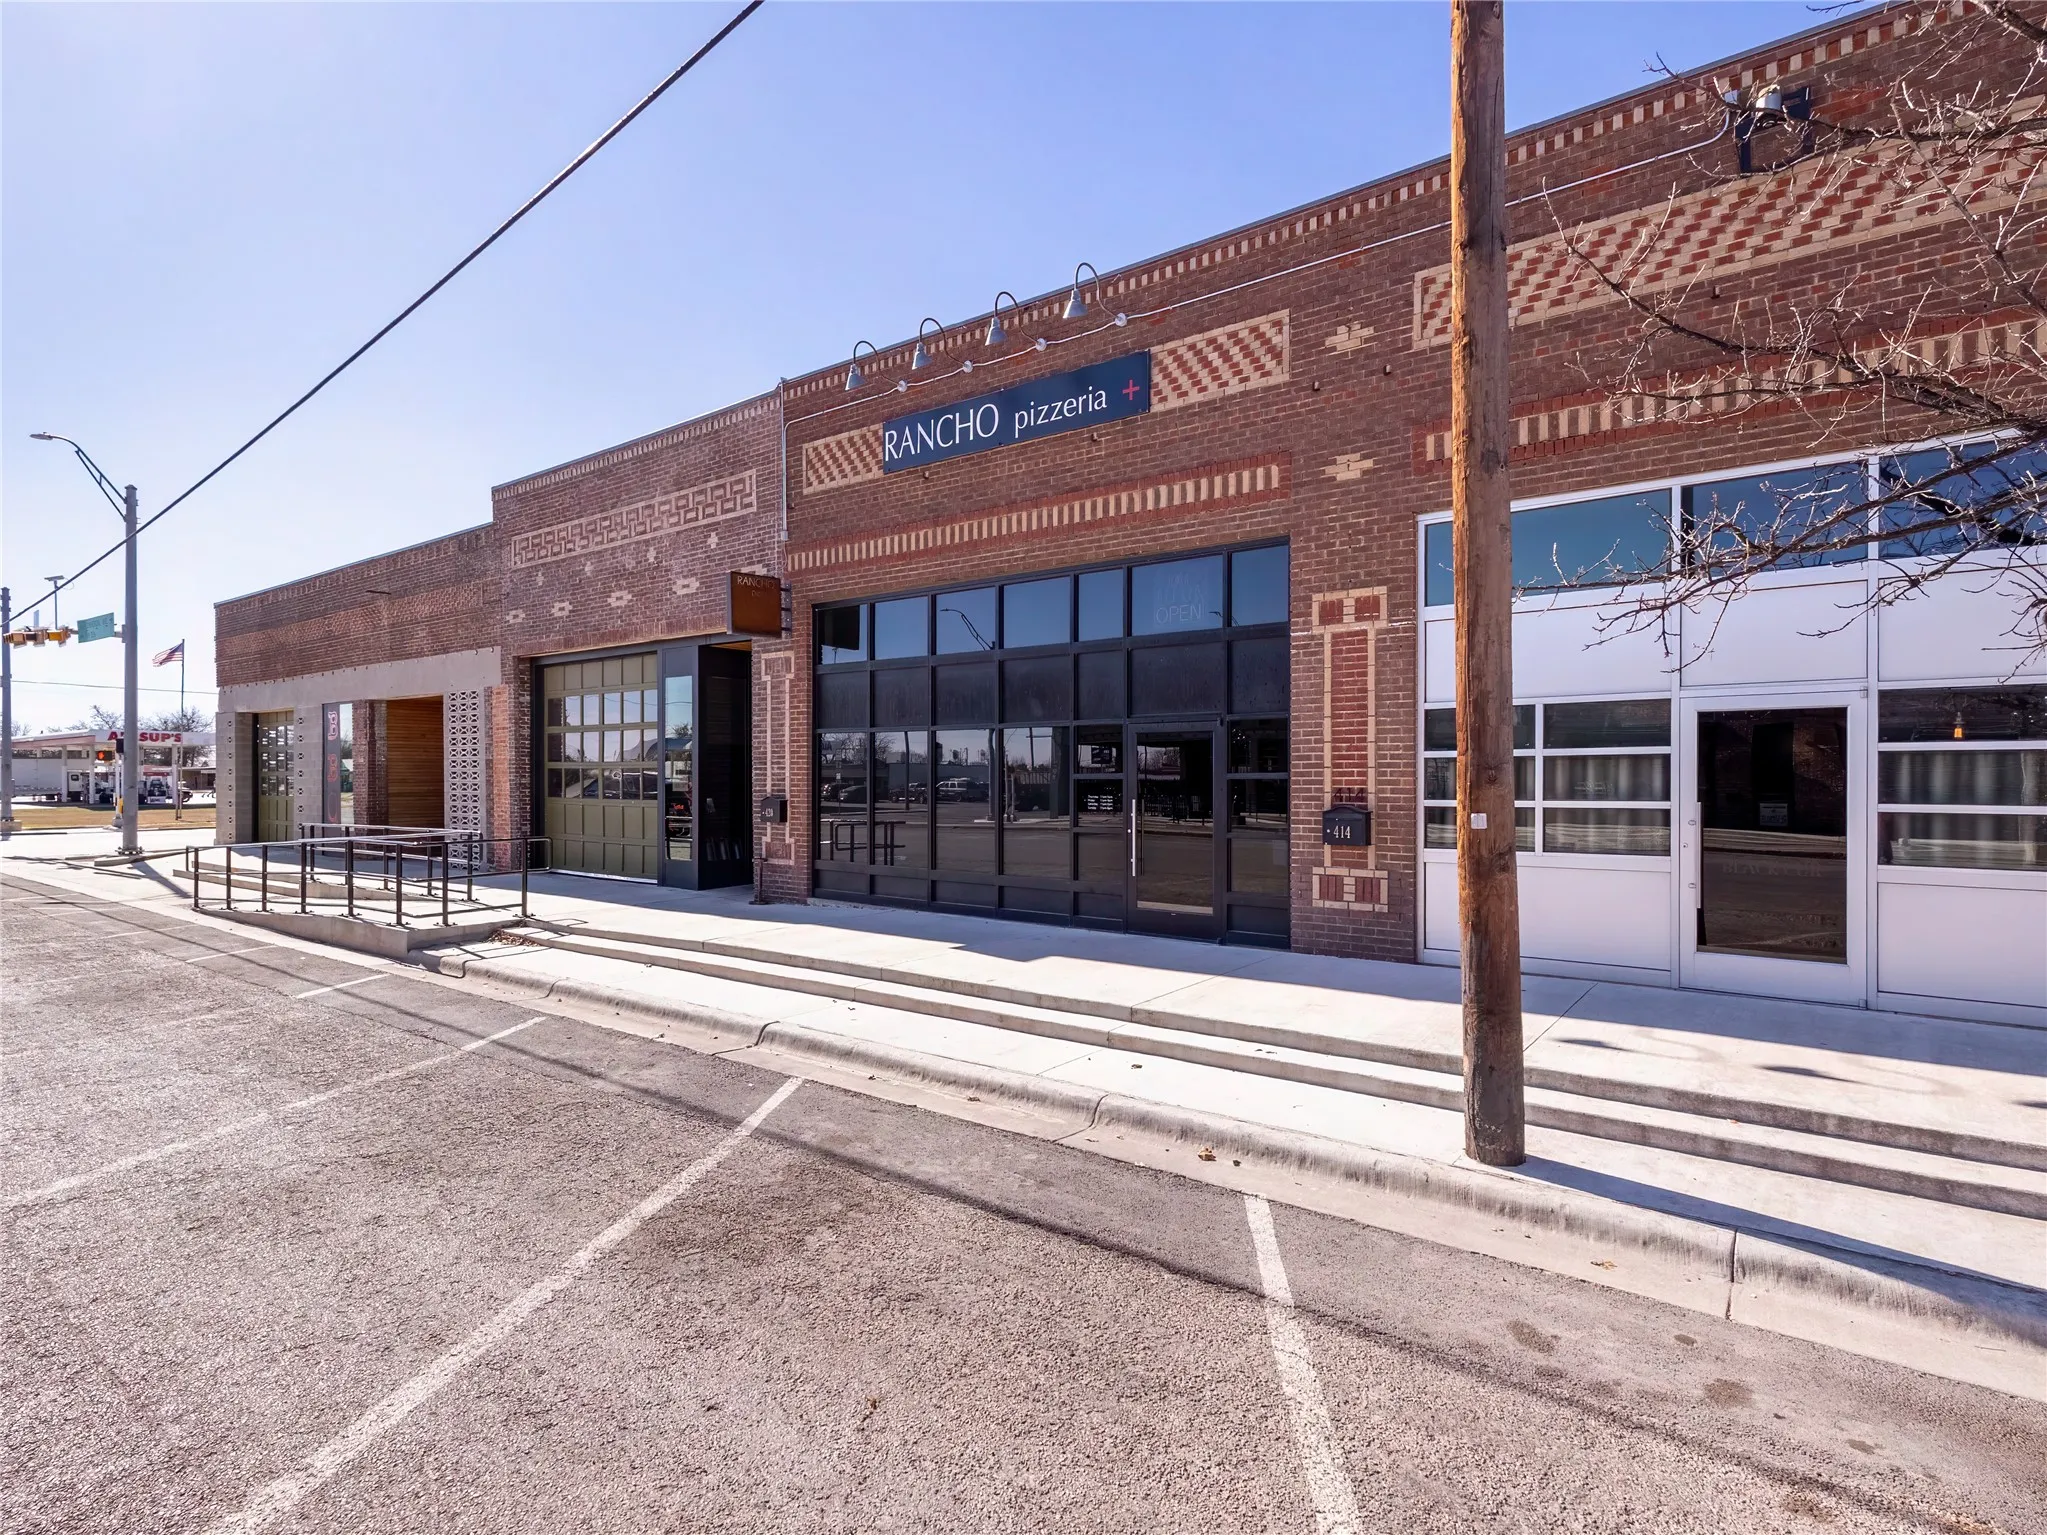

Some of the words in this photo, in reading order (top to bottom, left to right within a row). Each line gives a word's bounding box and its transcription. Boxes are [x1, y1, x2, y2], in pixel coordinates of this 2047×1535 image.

[884, 403, 1000, 462] RANCHO
[1014, 386, 1108, 438] pizzeria
[1156, 604, 1201, 624] OPEN
[1333, 826, 1351, 839] 414
